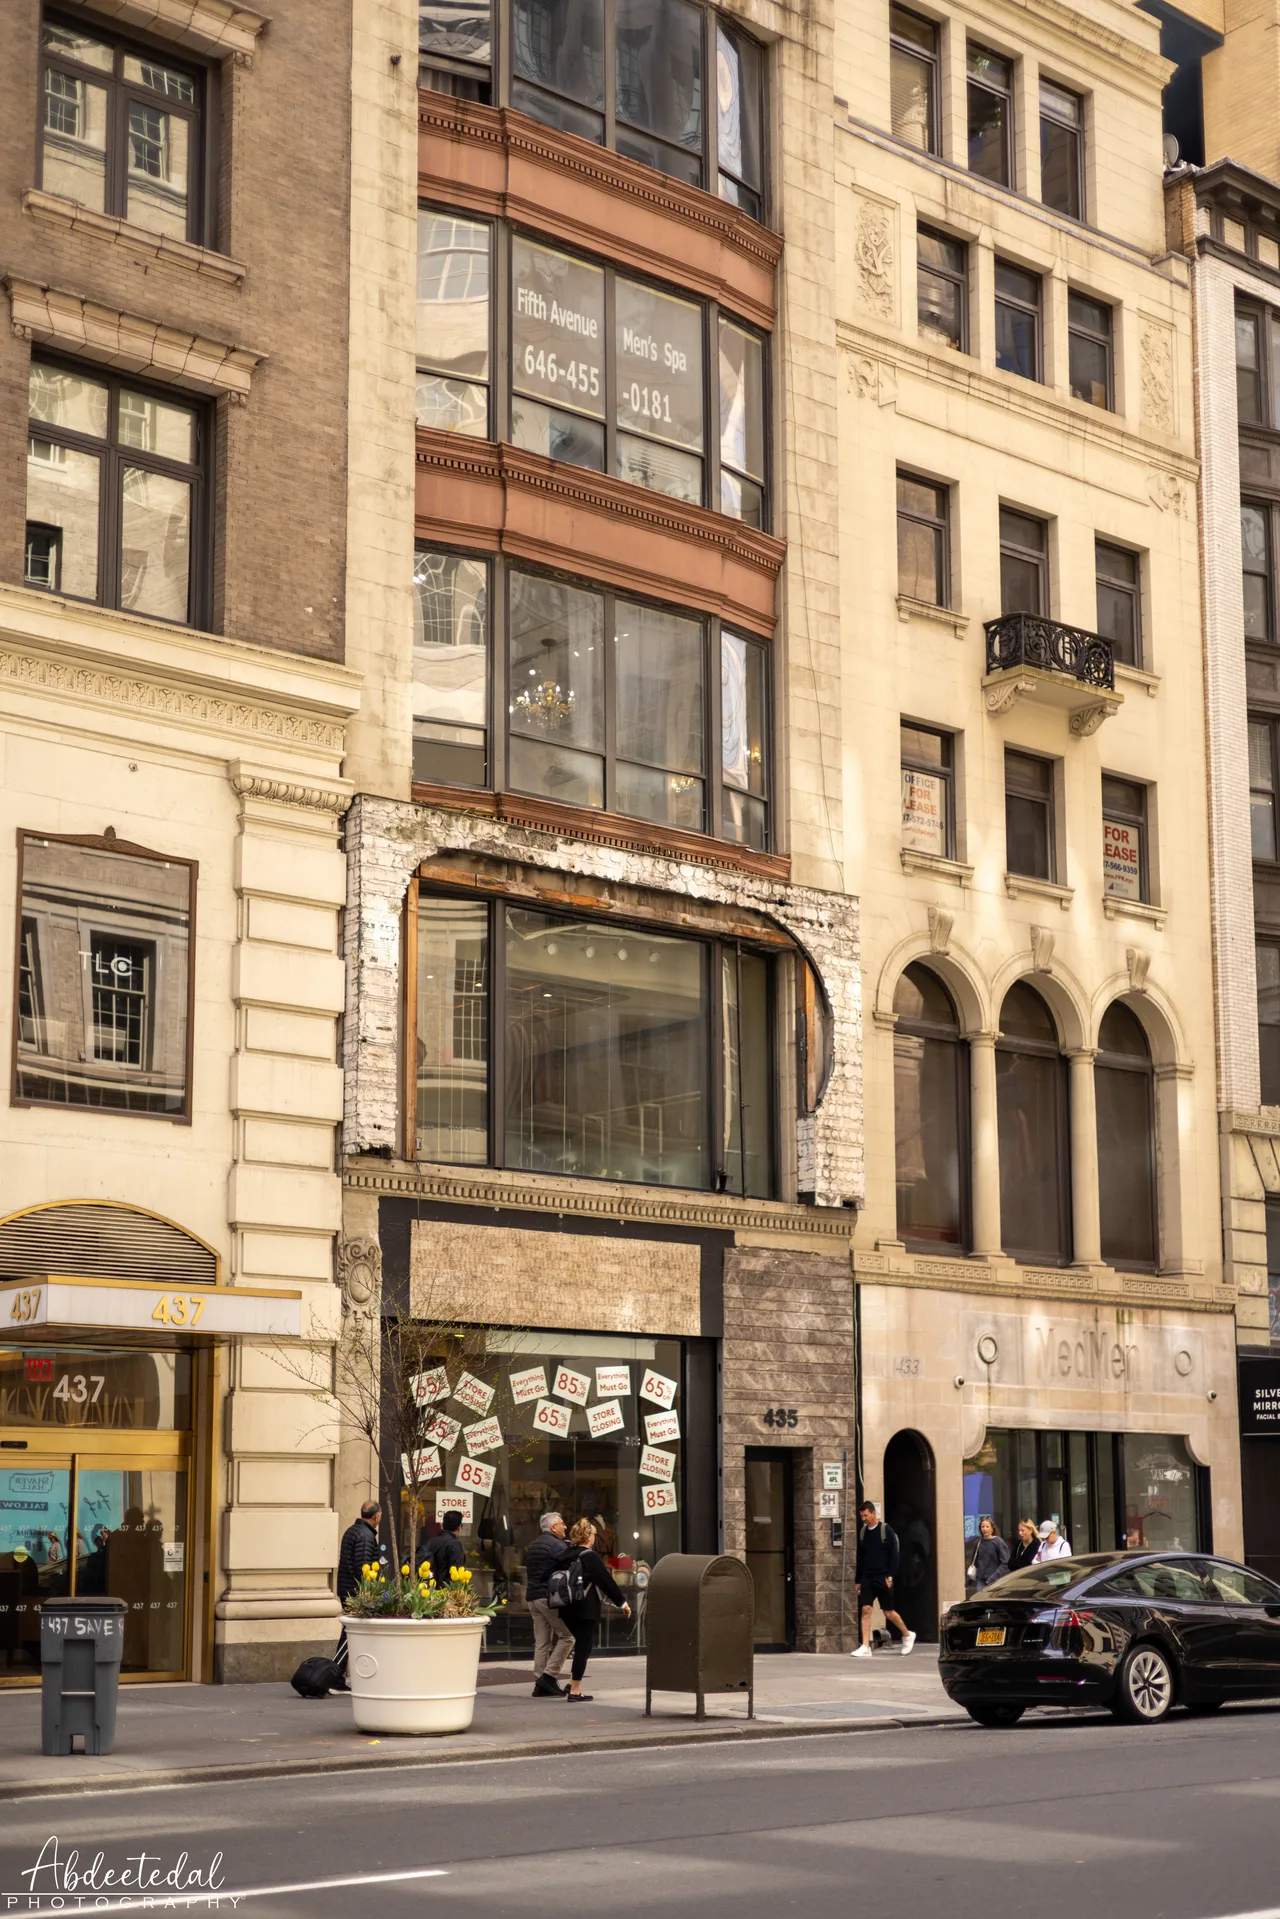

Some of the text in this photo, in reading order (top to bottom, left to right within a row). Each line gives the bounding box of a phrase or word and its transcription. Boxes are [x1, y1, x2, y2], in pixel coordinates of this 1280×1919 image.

[517, 287, 687, 374] Fifth Avenue Men's Spa
[524, 345, 600, 396] 646-455
[904, 774, 936, 790] OFFICE
[909, 786, 931, 801] FOR
[903, 798, 937, 815] LEASE
[1104, 825, 1130, 844] FOR
[1103, 843, 1137, 863] EASE
[78, 950, 132, 977] TLC
[10, 1289, 42, 1322] 437
[152, 1295, 207, 1326] 437
[1036, 1327, 1140, 1381] MedMen
[895, 1358, 920, 1375] 433
[512, 1374, 545, 1388] Everything
[557, 1373, 587, 1395] 85%
[597, 1372, 629, 1381] Everything
[53, 1375, 105, 1403] 437
[464, 1379, 488, 1399] STORE
[515, 1385, 545, 1398] Must Go
[599, 1383, 628, 1391] Must Go
[645, 1377, 673, 1398] 65%
[538, 1406, 568, 1427] 65%
[592, 1408, 616, 1422] STORE
[646, 1416, 677, 1429] Everything
[763, 1408, 799, 1429] 435
[465, 1423, 499, 1441] Everything
[591, 1417, 622, 1433] CLOSING
[650, 1427, 677, 1439] Must Go
[469, 1434, 500, 1450] Must Go
[646, 1453, 670, 1466] STORE
[461, 1463, 492, 1486] 85%
[641, 1463, 671, 1478] CLOSING
[441, 1498, 467, 1507] STORE
[646, 1488, 674, 1508] 85%
[821, 1493, 836, 1506] SH
[132, 1601, 178, 1610] 437 437 437
[48, 1616, 69, 1635] 437
